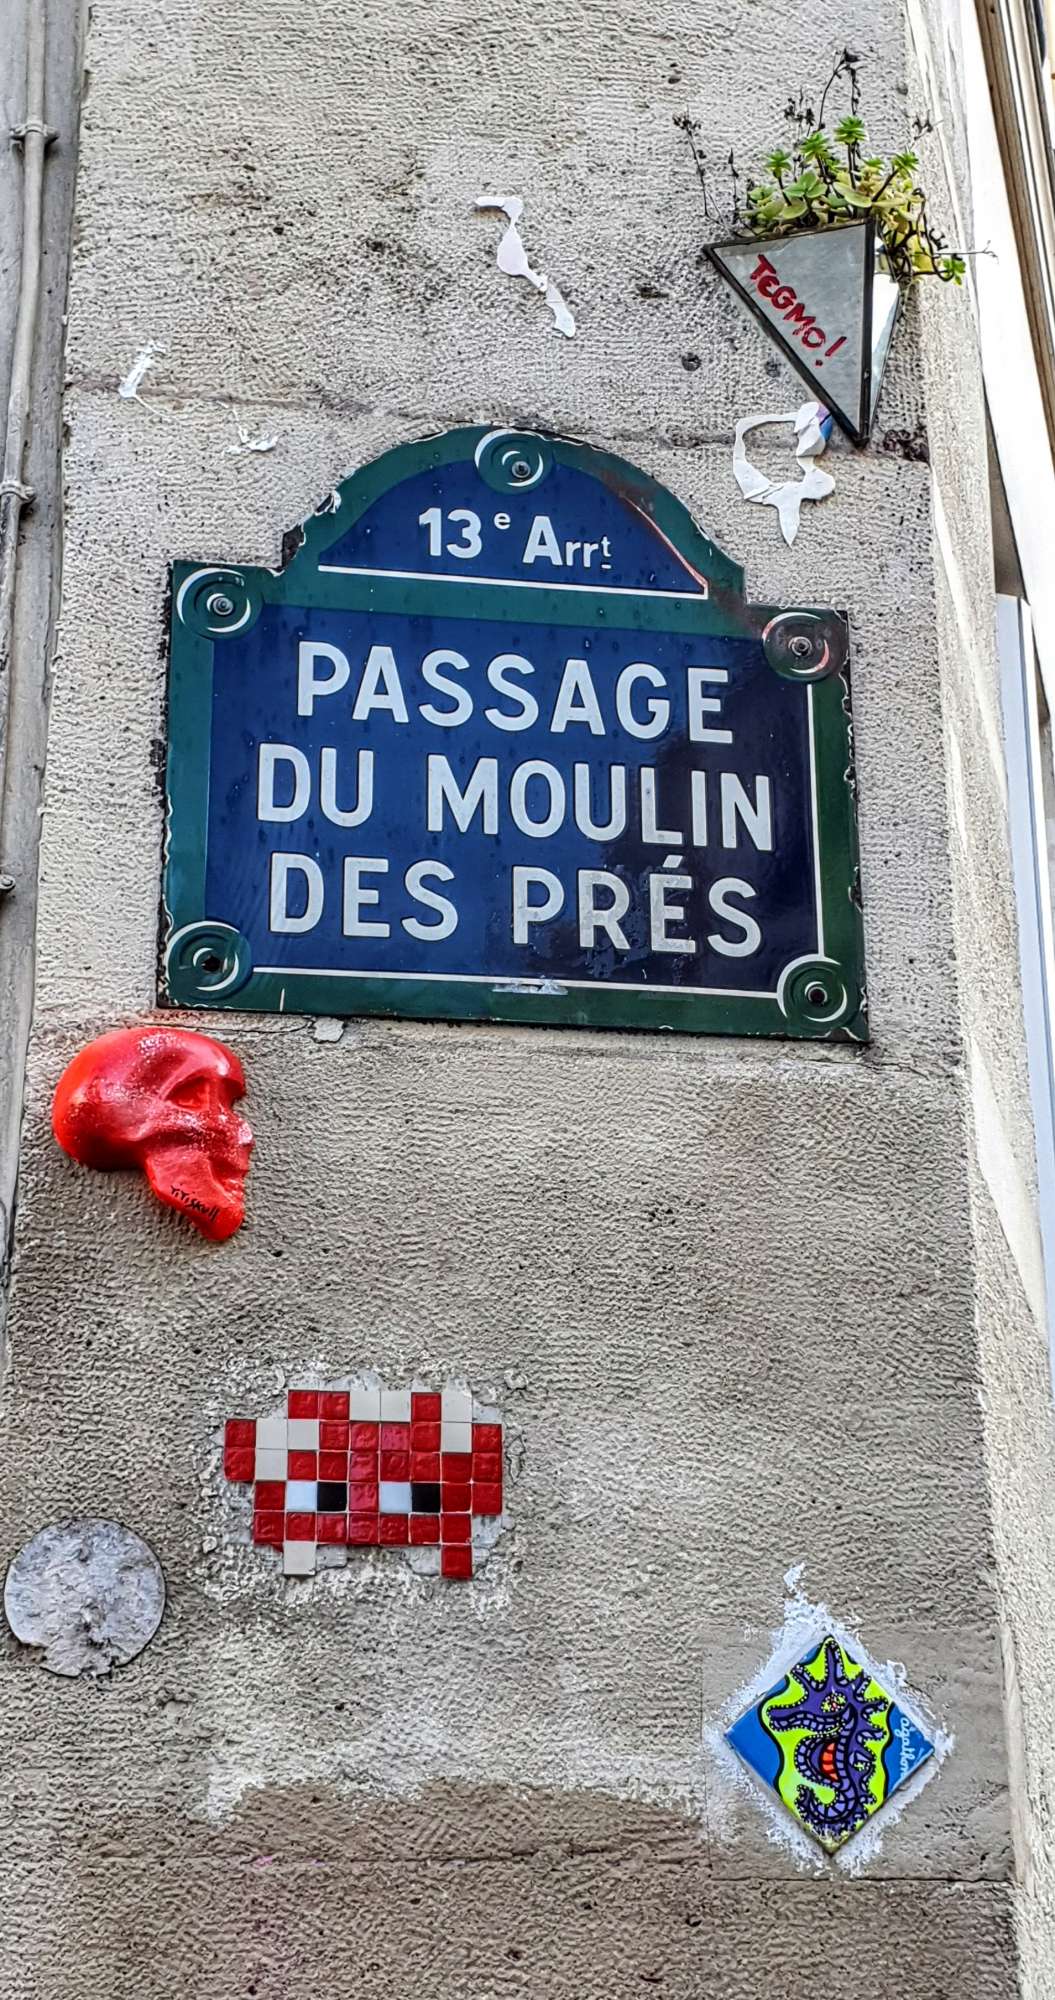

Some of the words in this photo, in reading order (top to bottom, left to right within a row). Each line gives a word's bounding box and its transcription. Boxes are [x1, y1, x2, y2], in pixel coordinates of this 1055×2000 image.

[297, 641, 733, 745] PASSAGE
[257, 743, 374, 827] DU
[427, 754, 774, 852] MOULIN
[269, 852, 459, 941] DES
[512, 854, 763, 957] PRÉS
